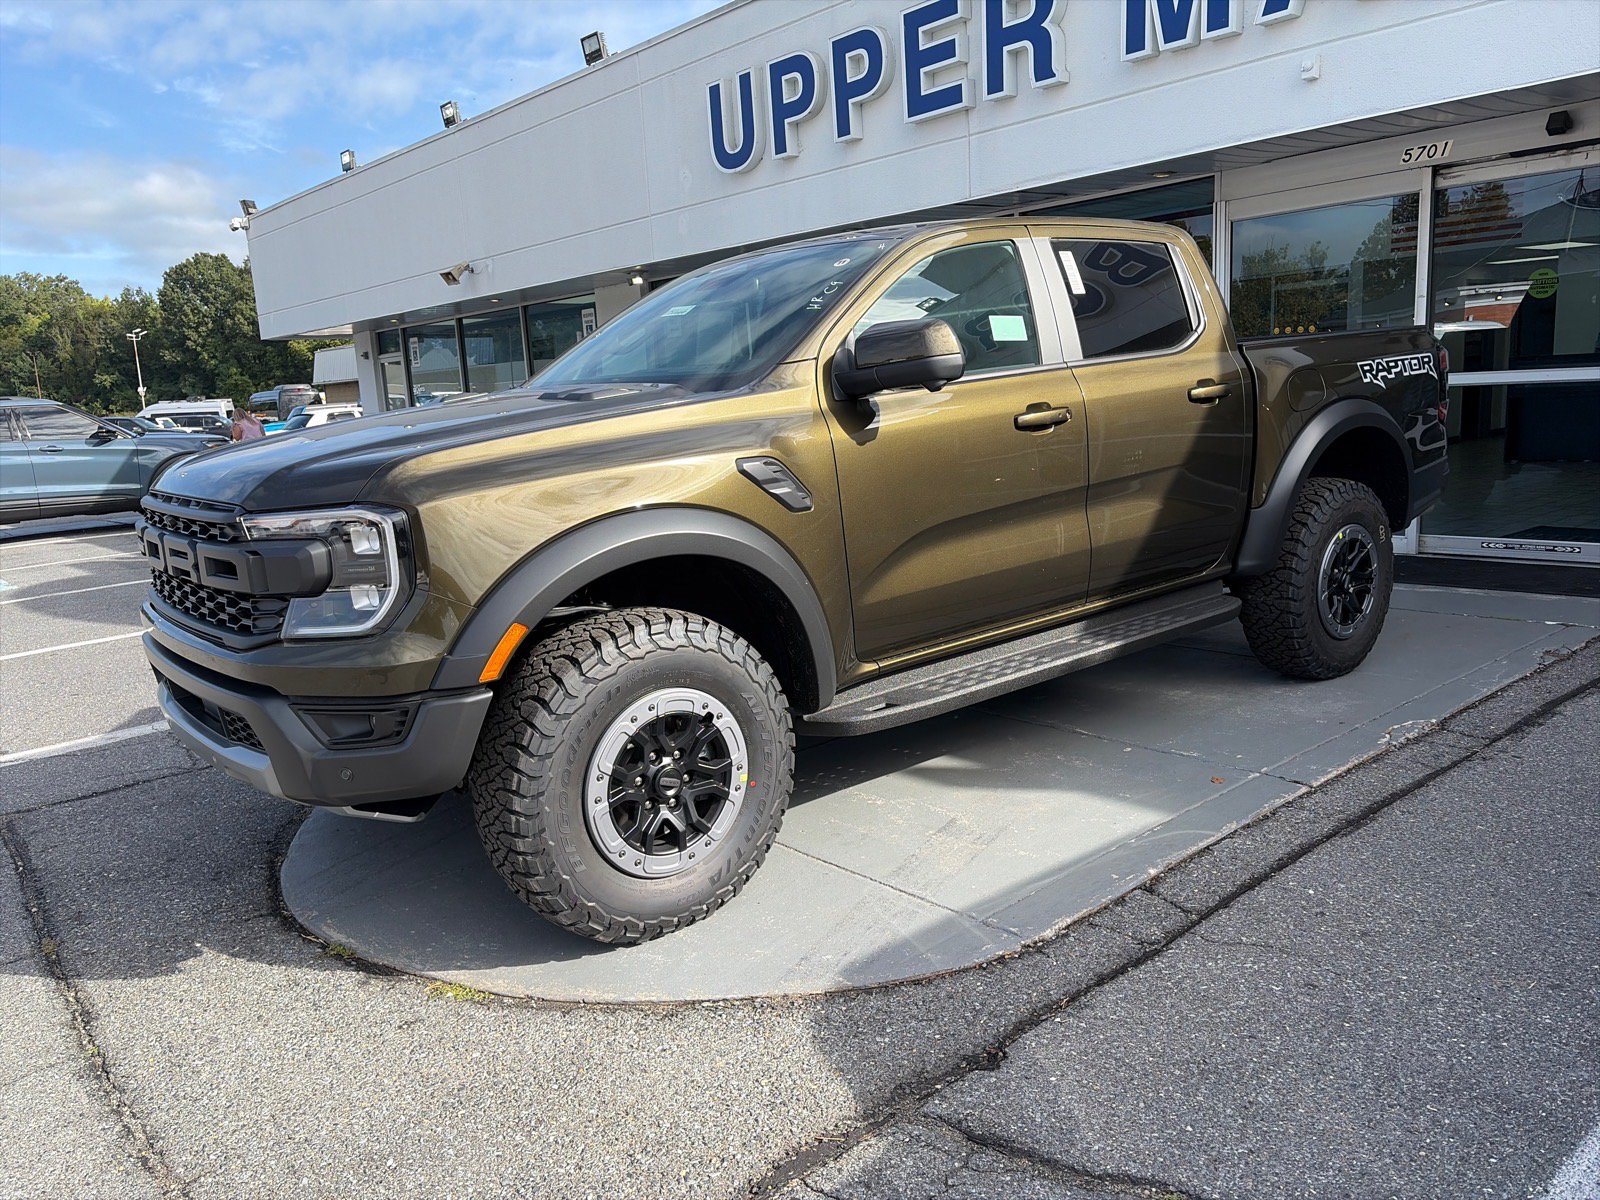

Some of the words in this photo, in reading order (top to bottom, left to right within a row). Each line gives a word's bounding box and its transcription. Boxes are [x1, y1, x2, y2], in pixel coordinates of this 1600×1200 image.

[706, 0, 1069, 173] UPPER
[1402, 141, 1449, 163] 5701
[1357, 353, 1438, 389] RAPTOR
